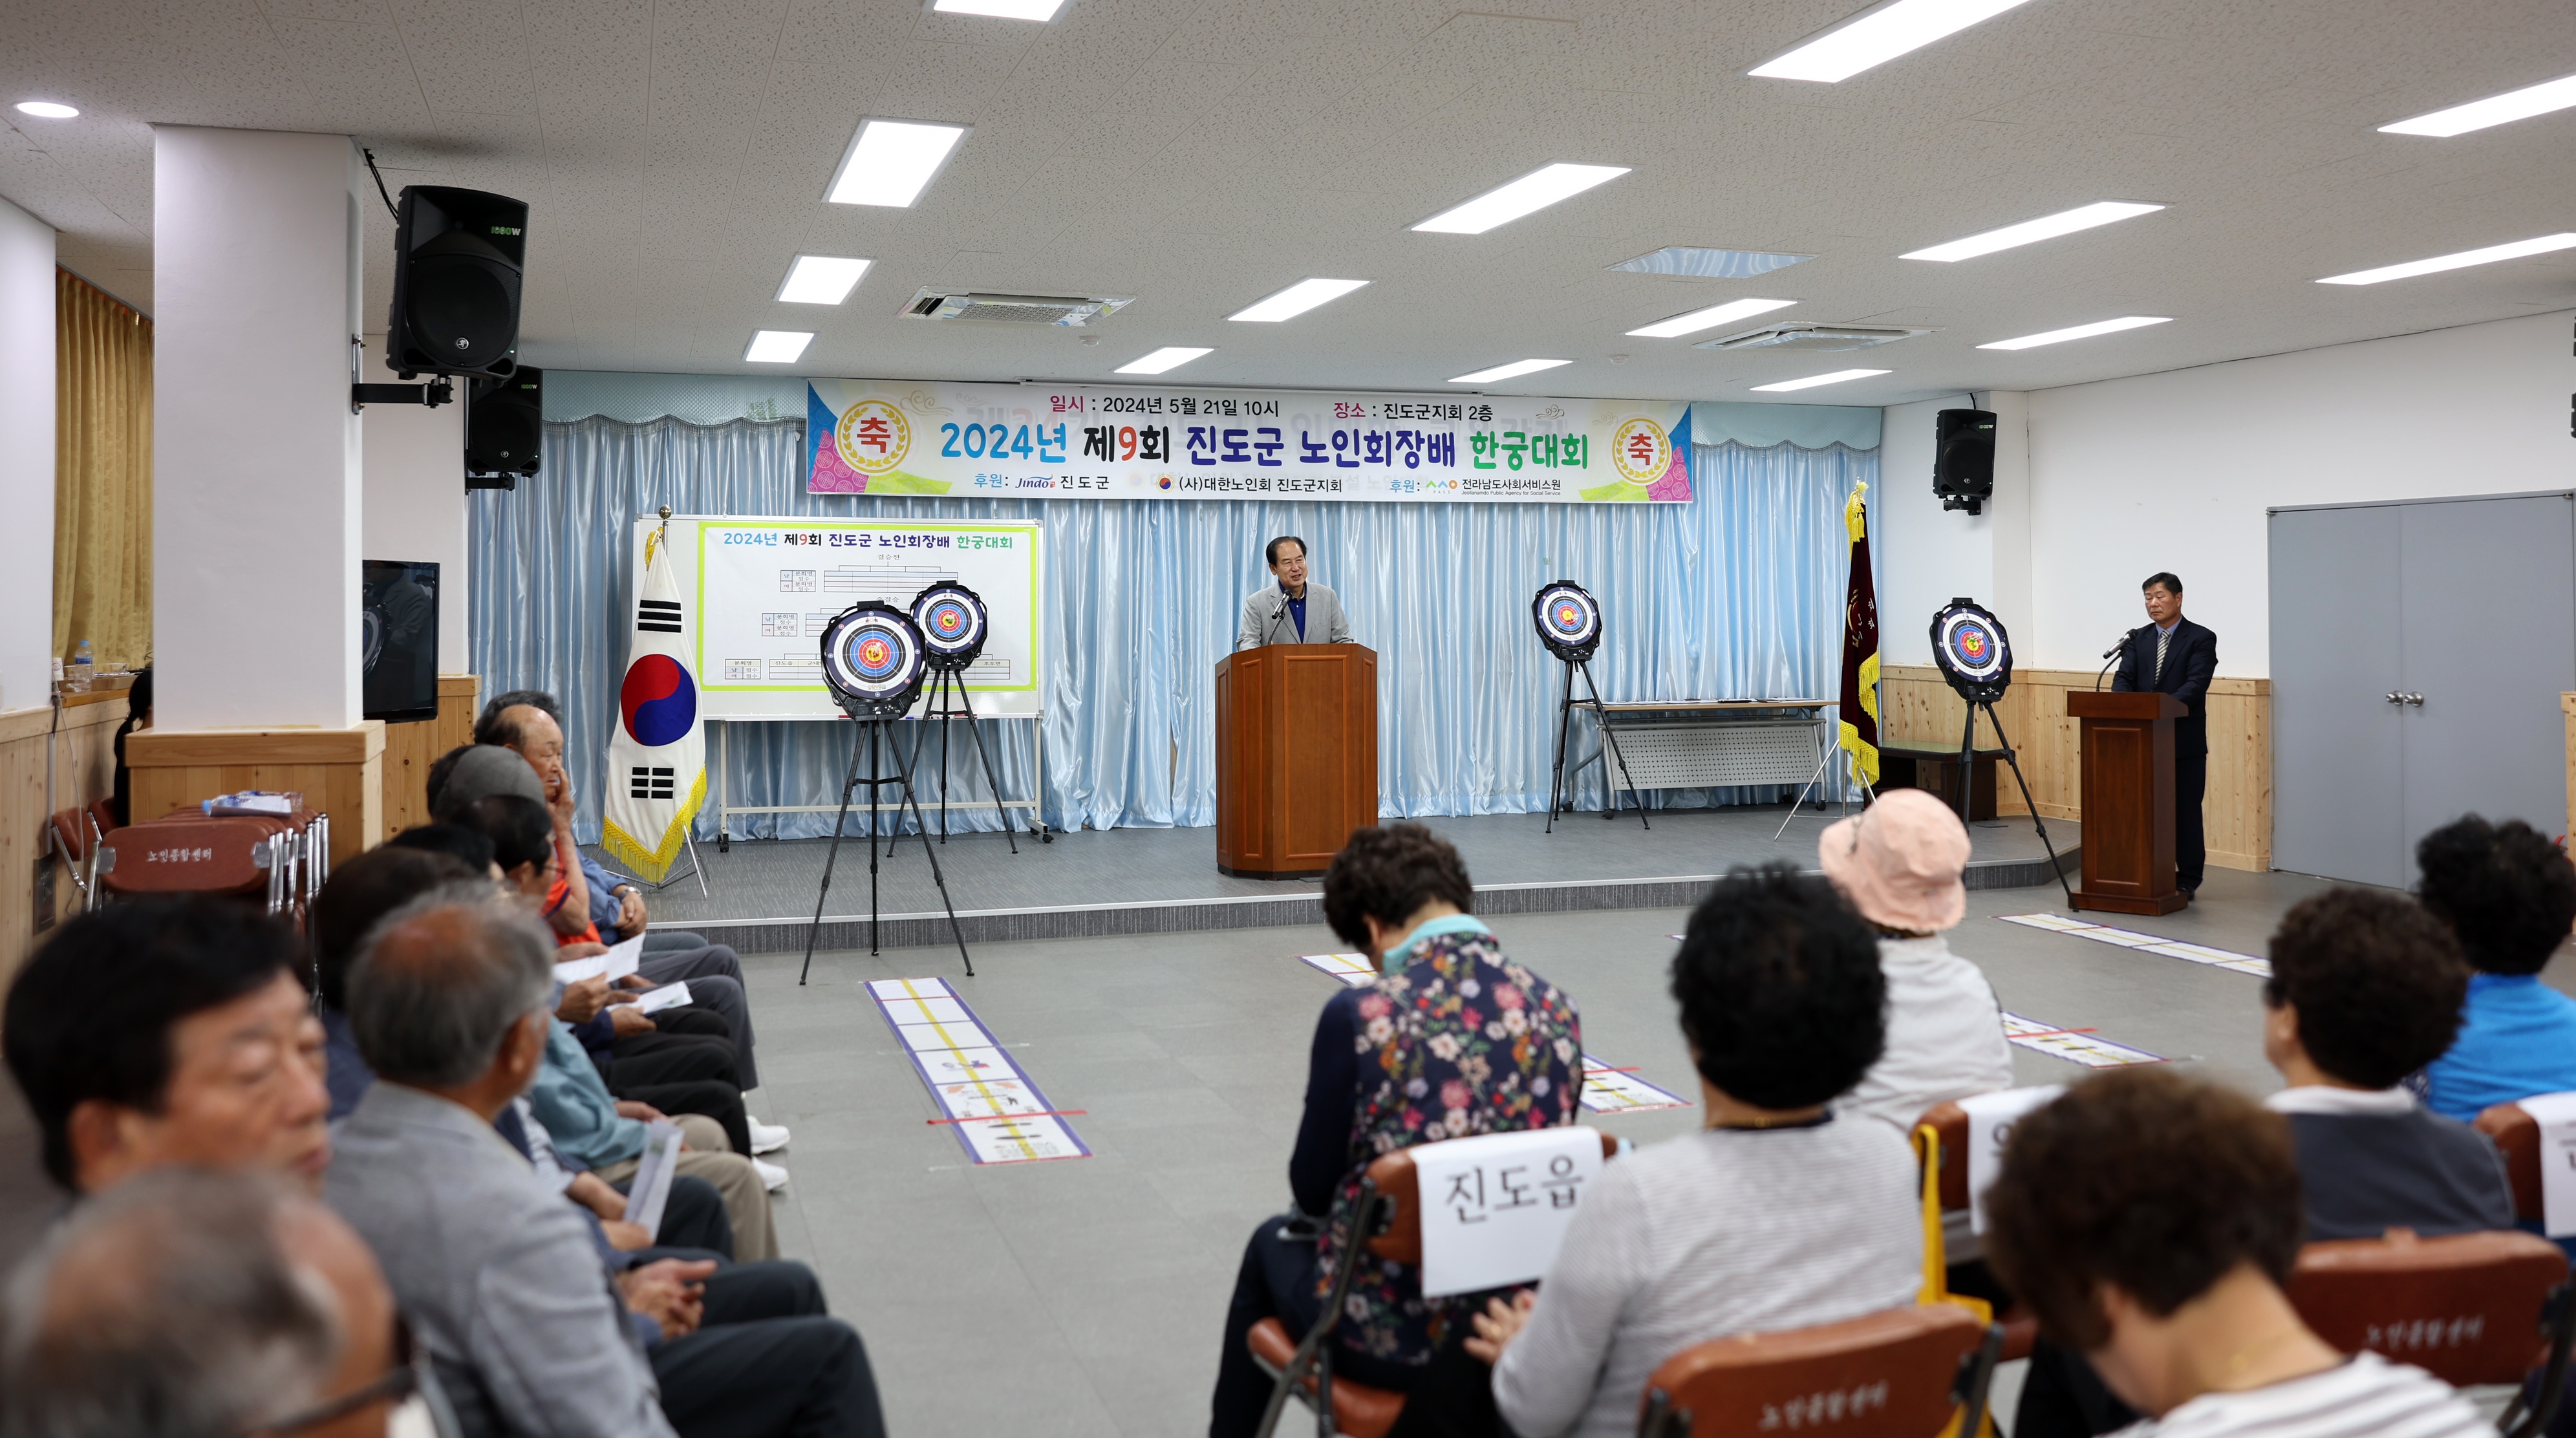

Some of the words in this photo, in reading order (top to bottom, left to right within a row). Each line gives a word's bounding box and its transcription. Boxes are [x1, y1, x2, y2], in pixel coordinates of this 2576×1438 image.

[1050, 395, 1084, 413] 일시
[1103, 397, 1162, 414] 2024년
[1170, 398, 1196, 414] 5월
[1203, 399, 1237, 416] 21일
[1244, 400, 1278, 417] 10시
[1333, 401, 1366, 418] 장소
[1383, 403, 1463, 422] 진도군지회
[1468, 405, 1493, 422] 2층
[856, 417, 891, 454] 축
[940, 422, 1066, 464] 2024년
[1084, 425, 1169, 464] 제9회
[1186, 425, 1284, 467] 진도군
[1300, 429, 1455, 469] 노인회장배
[1469, 431, 1588, 471] 한궁대회
[1627, 434, 1654, 467] 축
[1179, 476, 1271, 492] (사)대한노인회
[1277, 478, 1342, 493] 진도군지회
[1462, 478, 1561, 490] 전라남도사회서비스원
[724, 532, 777, 546] 2024년
[784, 533, 822, 546] 제9회
[829, 533, 872, 547] 진도군
[879, 535, 950, 548] 노인회장배
[957, 535, 1013, 549] 한궁대회
[145, 847, 212, 863] 노인종합센터
[1446, 1154, 1583, 1225] 진도읍
